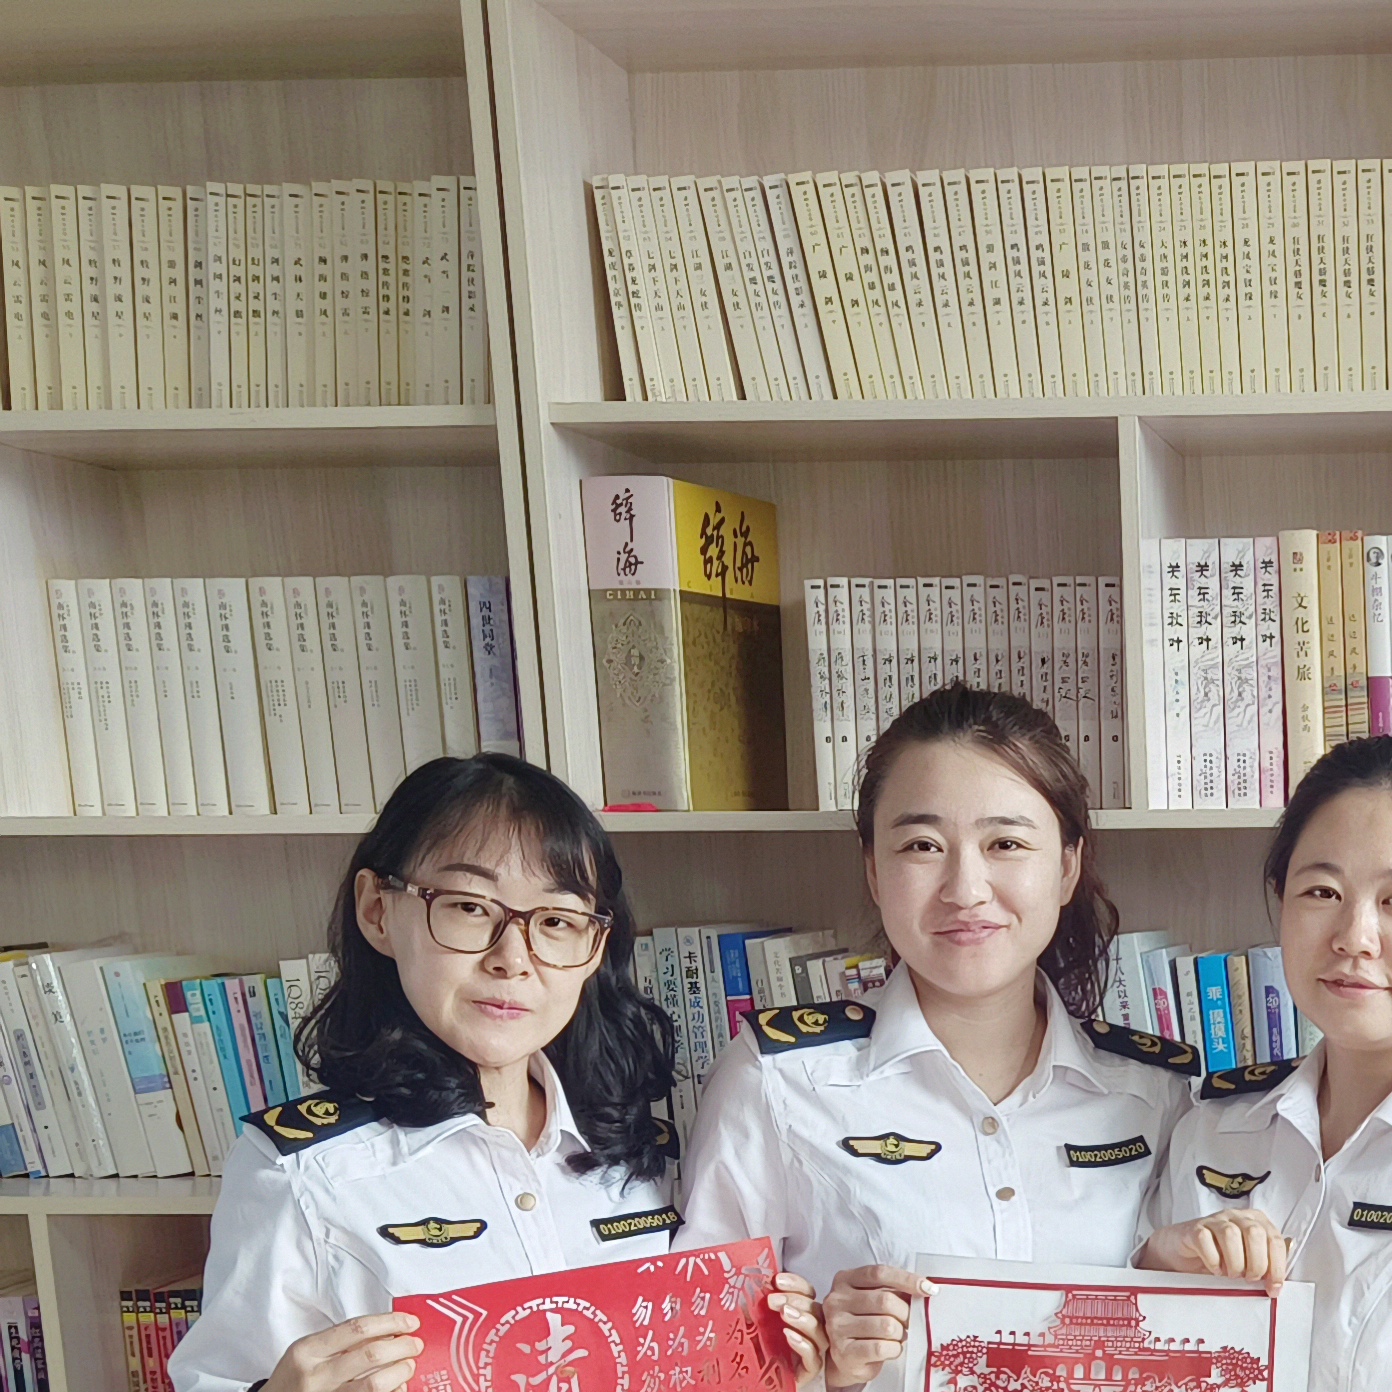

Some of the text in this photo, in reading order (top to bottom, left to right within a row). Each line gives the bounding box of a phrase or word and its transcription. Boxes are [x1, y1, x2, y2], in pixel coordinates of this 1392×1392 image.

[611, 488, 644, 577] 辞海
[699, 501, 760, 632] 辞海
[1292, 592, 1312, 682] 文化苦旅
[285, 978, 305, 1021] 1Q84
[683, 950, 710, 1069] 卡耐基成功管理学
